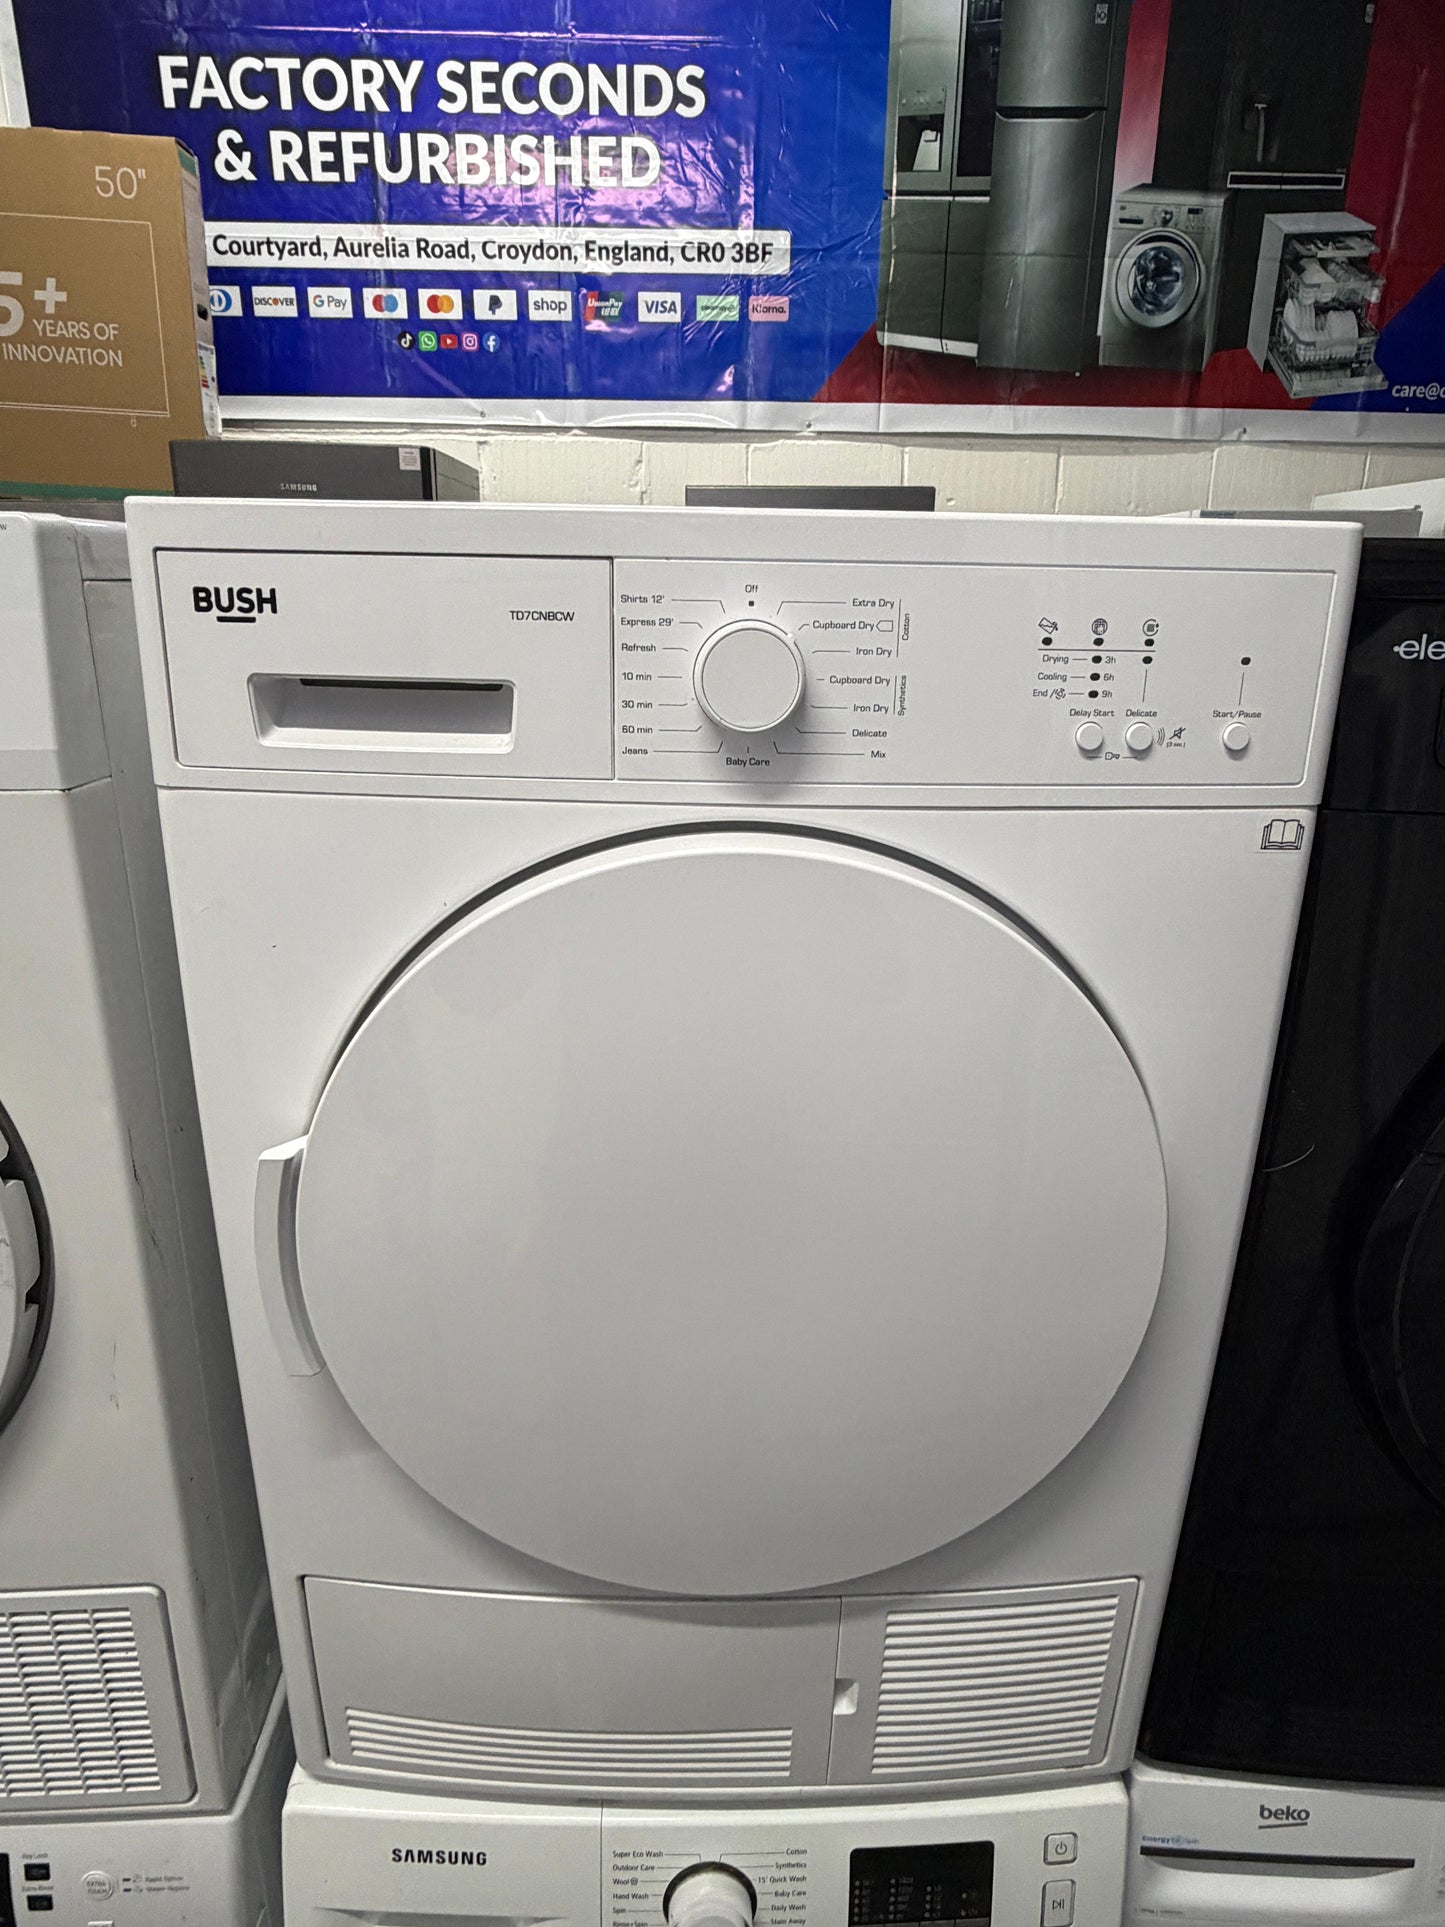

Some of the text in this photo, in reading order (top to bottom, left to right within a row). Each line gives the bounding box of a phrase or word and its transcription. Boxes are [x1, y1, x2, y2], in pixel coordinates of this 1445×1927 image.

[158, 55, 705, 117] FACTORY SECONDS
[214, 129, 660, 187] & REFURBISHED
[212, 234, 328, 260] Courtyard,
[333, 236, 410, 259] Aurelia
[415, 238, 475, 262] Road,
[481, 238, 578, 264] Croydon,
[585, 240, 674, 266] England,
[731, 243, 774, 263] 3BF
[327, 295, 347, 309] Pay
[533, 297, 568, 314] shop
[644, 300, 678, 315] VISA
[33, 318, 119, 341] YEARS OF
[2, 343, 123, 368] INNOVATION
[280, 483, 318, 492] SAMSUNG
[745, 584, 759, 594] Off
[192, 586, 278, 615] BUSH
[620, 594, 649, 604] Shirts
[852, 598, 895, 610] Extra Dry
[620, 617, 657, 628] Express
[812, 620, 875, 632] Cupboard Dry
[901, 613, 910, 641] Cotton
[621, 642, 656, 652] Refresh
[855, 647, 892, 659] Iron Dry
[1042, 655, 1069, 665] Drying
[1104, 655, 1117, 664] 3h
[622, 671, 652, 681] 10 min
[829, 675, 891, 687] Cupboard Dry
[1037, 672, 1068, 683] Cooling
[1103, 673, 1115, 682] 6h
[897, 675, 907, 716] Synthetics
[1032, 690, 1048, 698] End
[1101, 690, 1113, 698] 9h
[621, 699, 653, 709] 30 min
[853, 704, 889, 715] Iron Dry
[1069, 709, 1115, 719] Delay Start
[1125, 708, 1158, 718] Delicate
[1212, 709, 1262, 720] Start/Pause
[636, 724, 653, 734] min
[852, 729, 888, 739] Delicate
[622, 746, 648, 756] Jeans
[870, 750, 886, 759] Mix
[725, 757, 770, 768] Baby Care
[1259, 1804, 1311, 1822] beko
[391, 1847, 488, 1867] SAMSUNG
[612, 1850, 664, 1859] Super Eco Wash
[786, 1847, 808, 1857] Cotton
[612, 1863, 655, 1872] Outdoor Care
[775, 1861, 807, 1872] Synthetics
[612, 1878, 630, 1886] Wool
[769, 1876, 788, 1885] Quick
[789, 1875, 807, 1883] Wash
[612, 1892, 649, 1900] Hand Wash
[774, 1888, 807, 1898] Baby Care
[612, 1906, 627, 1915] Spin
[789, 1903, 807, 1911] Wash
